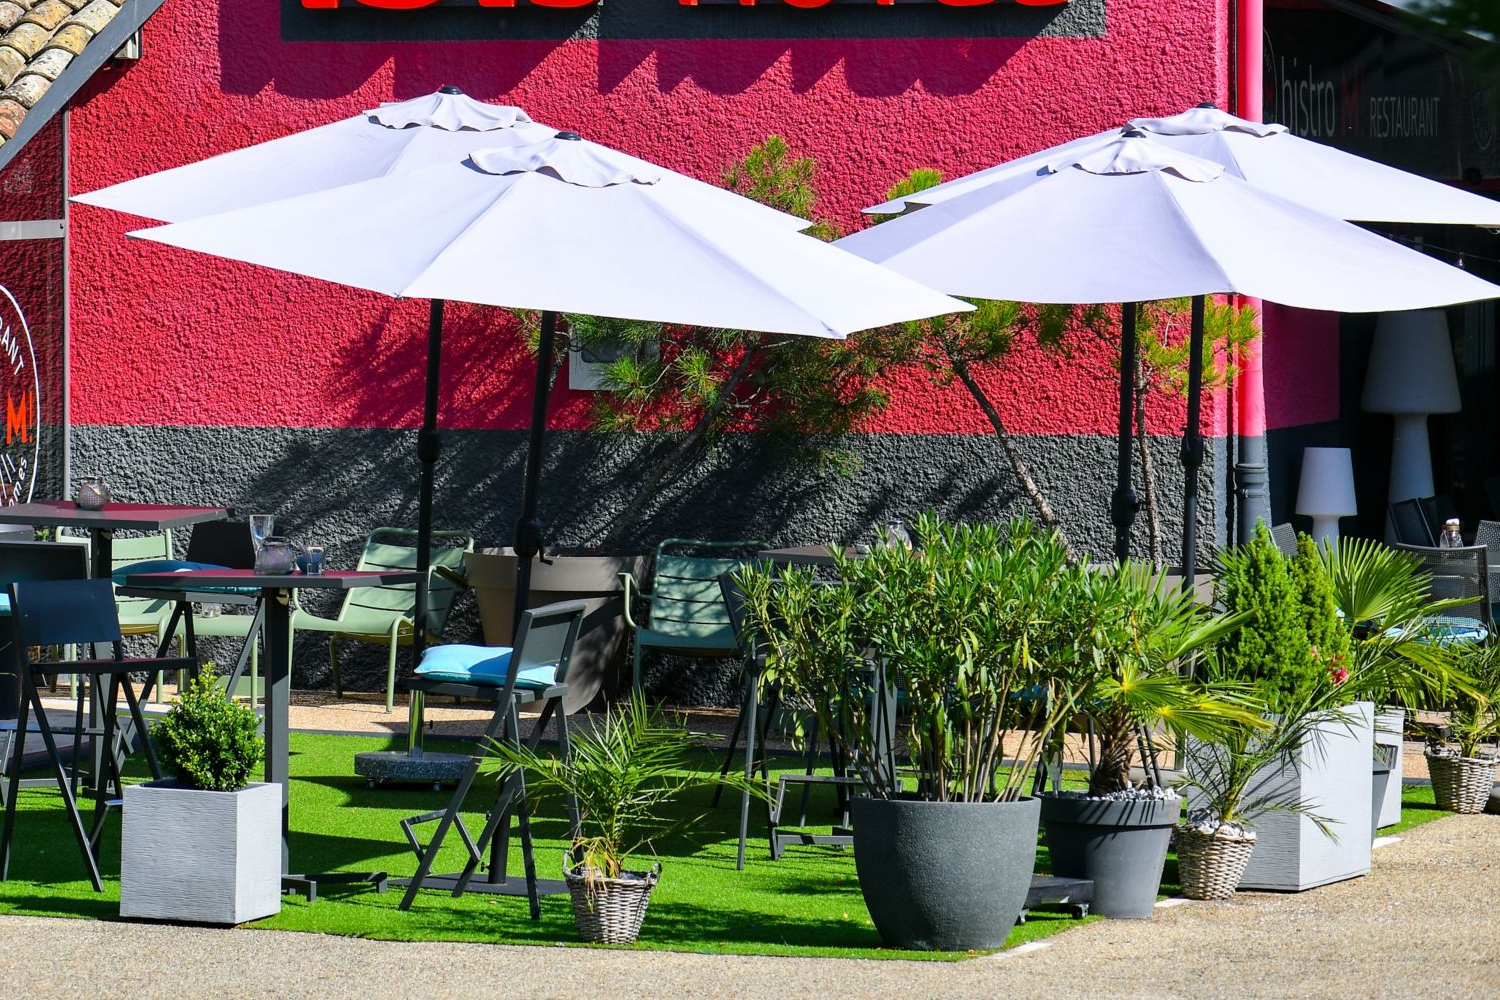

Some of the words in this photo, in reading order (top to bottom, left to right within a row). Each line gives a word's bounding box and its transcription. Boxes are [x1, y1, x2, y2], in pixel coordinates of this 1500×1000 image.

[1281, 56, 1336, 137] bistro
[1369, 96, 1440, 138] RESTAURANT
[6, 391, 34, 445] M!
